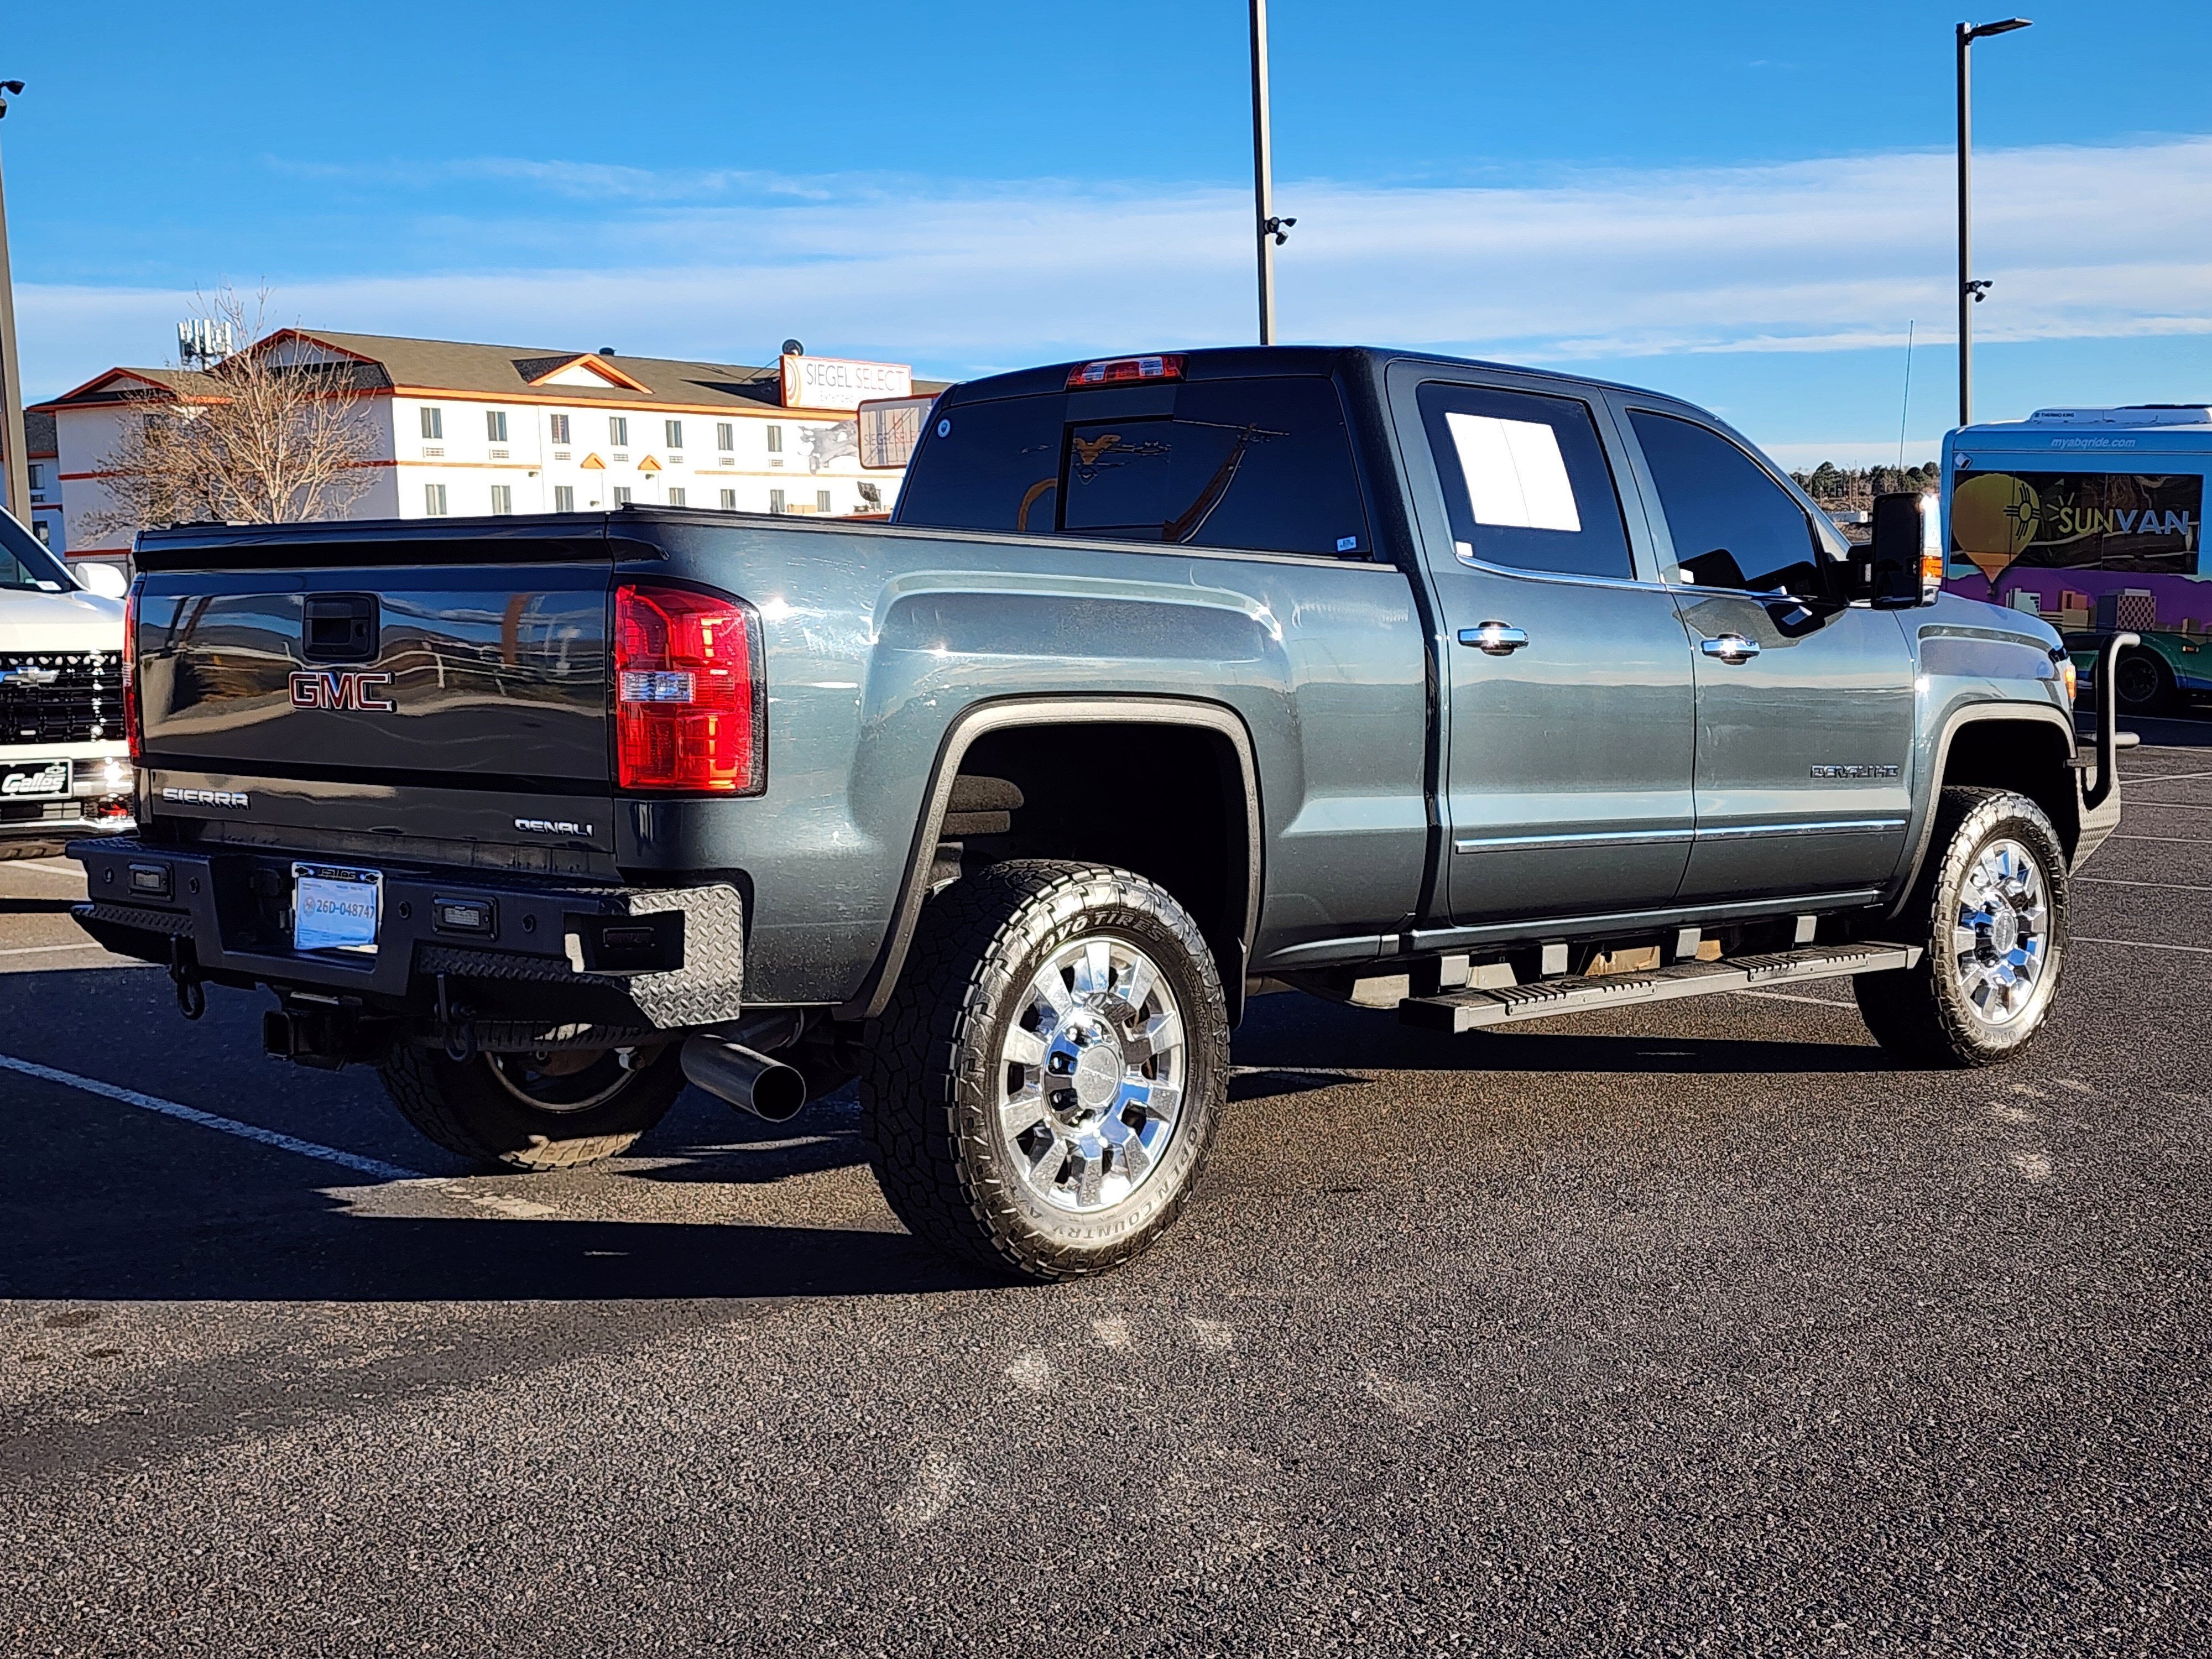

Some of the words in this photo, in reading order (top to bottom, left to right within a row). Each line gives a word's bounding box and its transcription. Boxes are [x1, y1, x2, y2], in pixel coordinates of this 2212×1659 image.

[806, 363, 852, 388] SIEGEL
[856, 368, 904, 391] SELECT
[2051, 437, 2136, 449] myabqride.com
[289, 671, 396, 712] GMC
[1, 773, 66, 793] Galles
[163, 787, 249, 811] SIERRA
[514, 818, 593, 837] DENALI
[316, 899, 374, 919] 26D-048747
[1027, 914, 1090, 969] TOYO
[1093, 910, 1168, 942] TIRES
[1156, 1123, 1201, 1201] OPEN
[1052, 1200, 1154, 1239] COUNTRY
